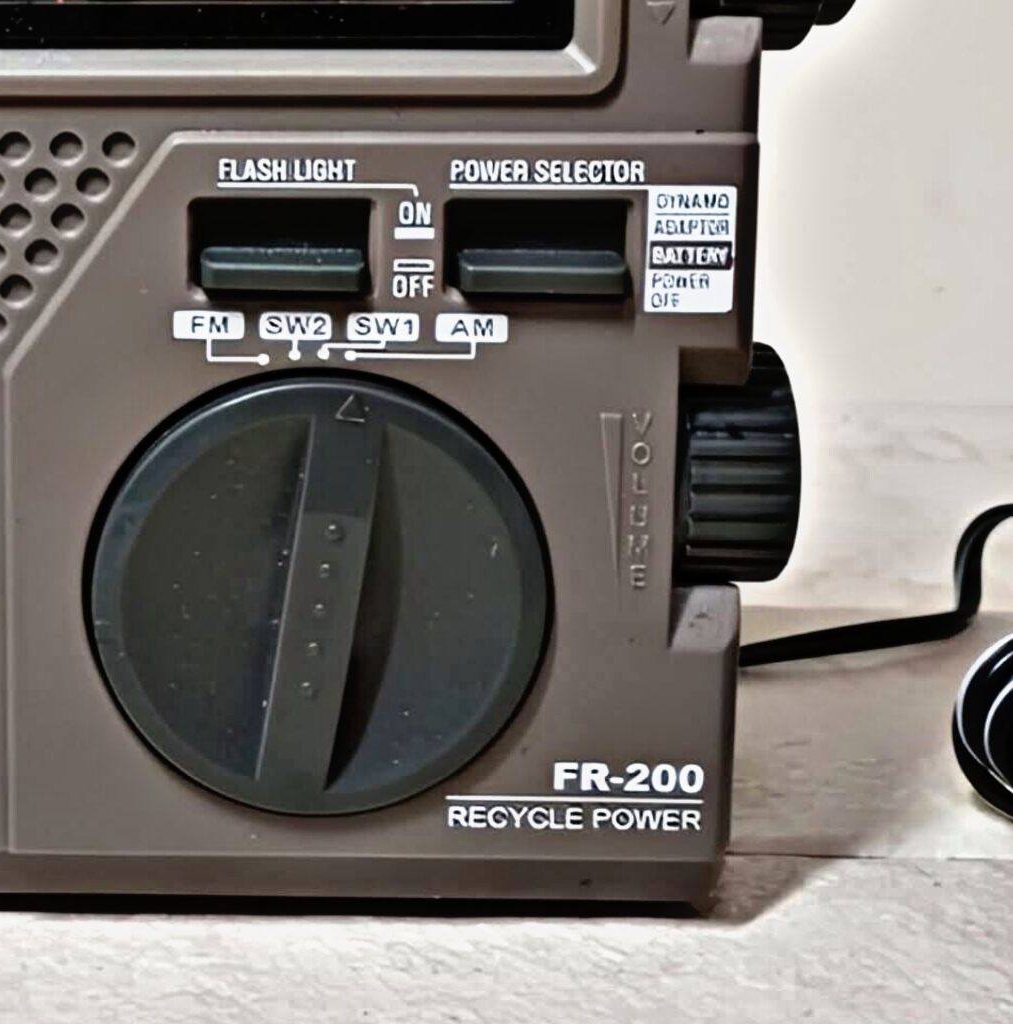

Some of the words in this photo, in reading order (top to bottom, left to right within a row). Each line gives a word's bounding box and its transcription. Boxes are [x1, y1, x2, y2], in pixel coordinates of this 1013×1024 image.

[218, 158, 288, 182] FLASH
[295, 158, 356, 182] LIGHT
[450, 159, 529, 183] POWER
[535, 159, 645, 183] SELECTOR
[399, 201, 432, 225] ON
[652, 246, 729, 265] BATTERY
[392, 275, 435, 298] OFF
[191, 316, 229, 333] FM
[266, 316, 327, 336] SW2
[355, 316, 414, 336] SW1
[451, 318, 494, 337] AM
[628, 411, 652, 587] VOLUME
[553, 762, 705, 793] FR-200
[448, 805, 584, 830] RECYCLE
[592, 807, 701, 831] POWER
